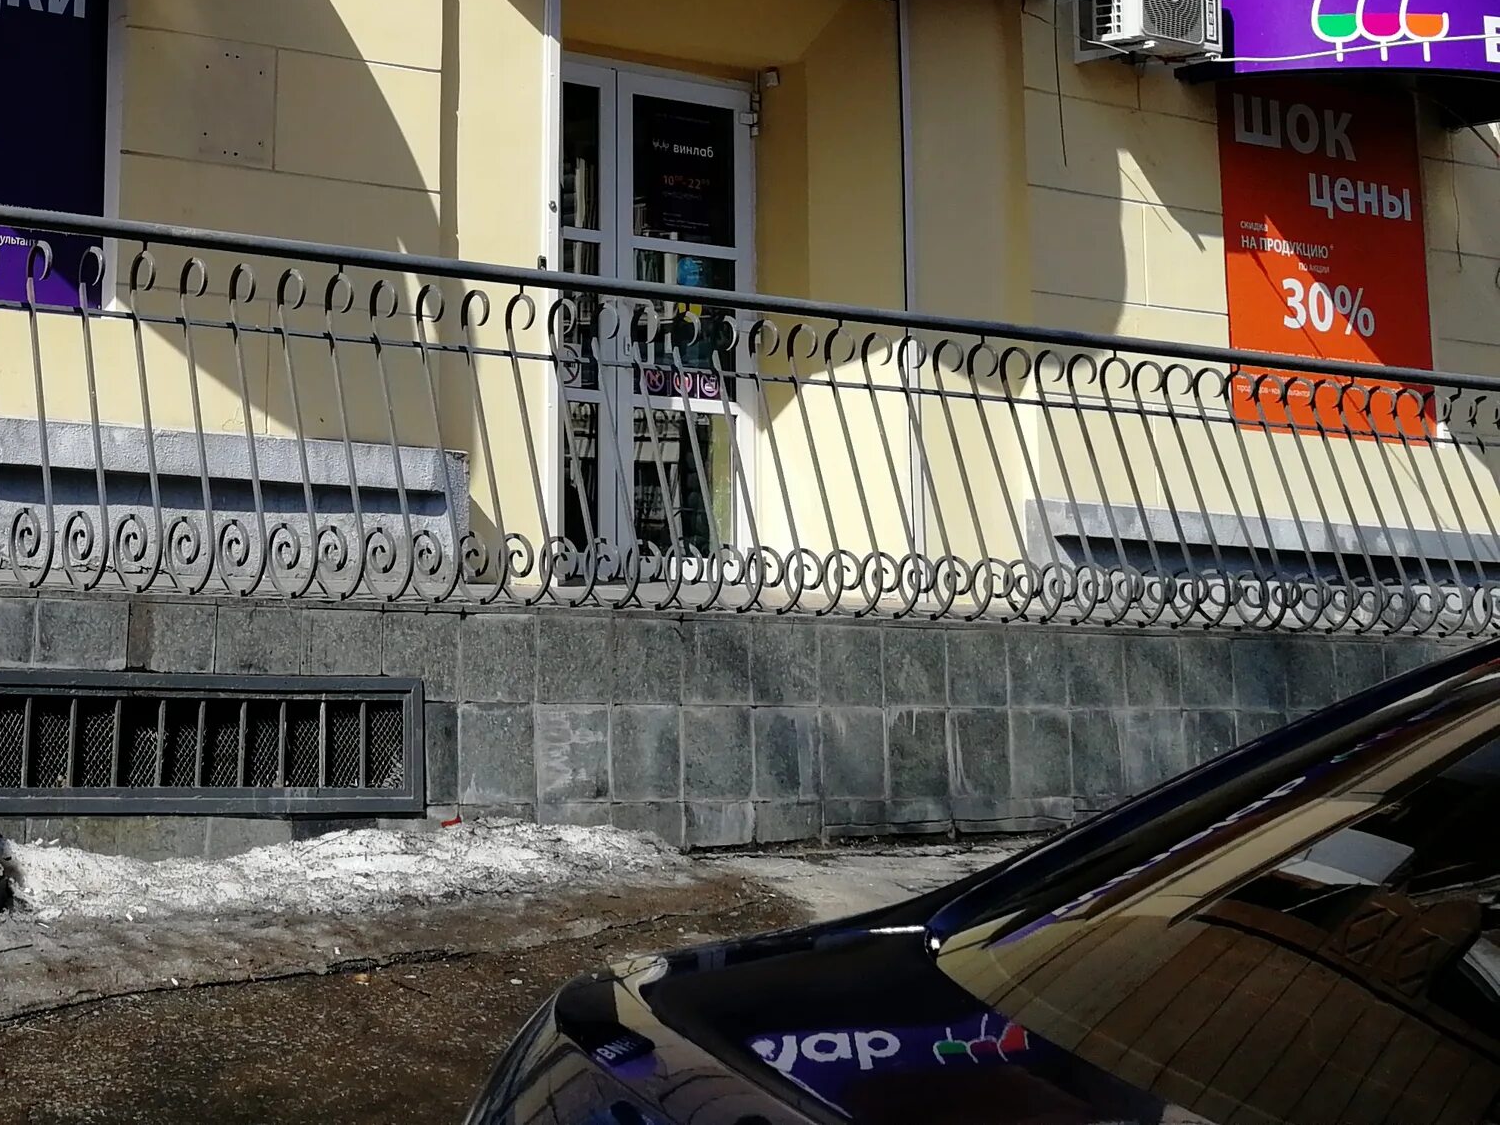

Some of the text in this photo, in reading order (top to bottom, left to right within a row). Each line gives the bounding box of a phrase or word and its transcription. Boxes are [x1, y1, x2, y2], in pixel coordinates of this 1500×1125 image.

[1233, 92, 1357, 162] ШОК
[1308, 172, 1412, 223] цены
[1241, 235, 1257, 250] НА
[1282, 278, 1375, 337] 30%
